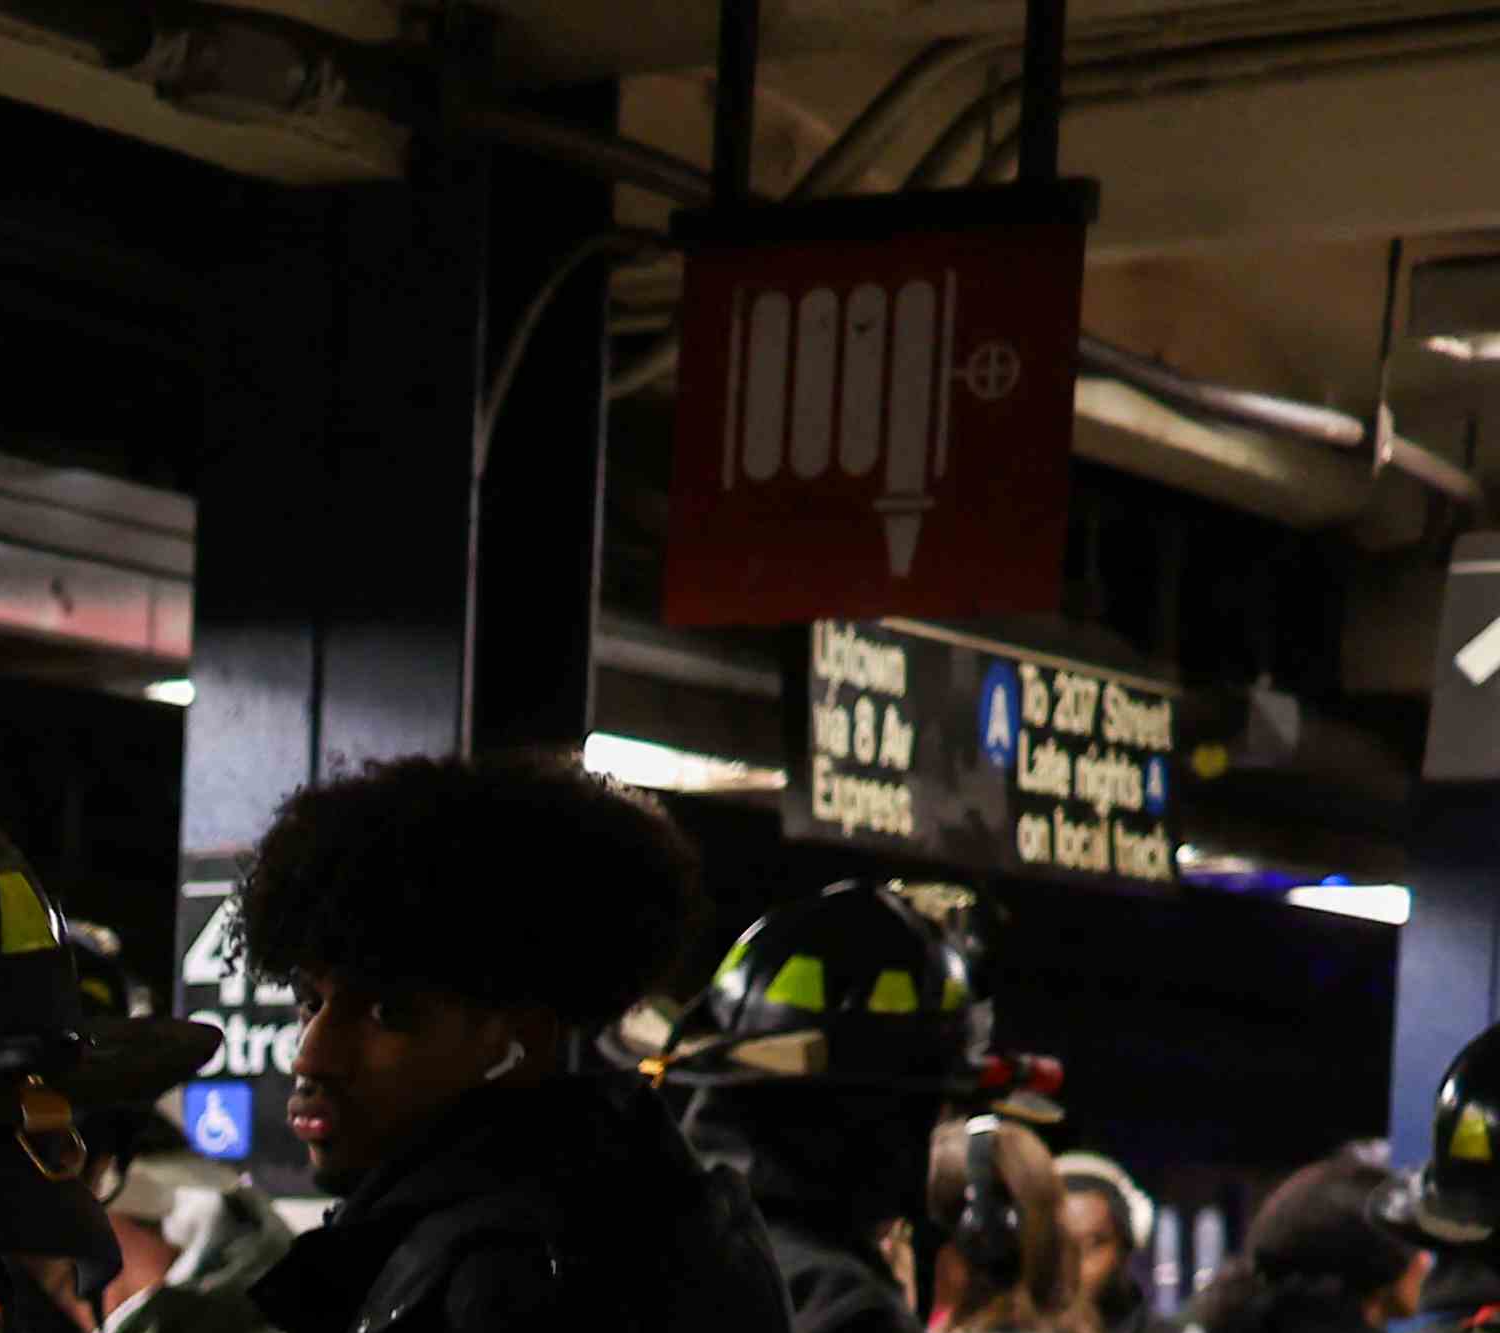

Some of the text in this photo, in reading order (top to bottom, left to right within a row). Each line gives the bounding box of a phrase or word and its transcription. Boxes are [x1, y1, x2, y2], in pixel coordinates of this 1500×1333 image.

[813, 620, 907, 706] Uptown
[854, 696, 877, 764] 8
[986, 683, 1011, 750] A
[1018, 662, 1173, 751] To 207 Street
[813, 754, 914, 837] Express
[1017, 728, 1071, 798] Late
[1074, 743, 1143, 818] nights
[1017, 805, 1173, 881] on local track
